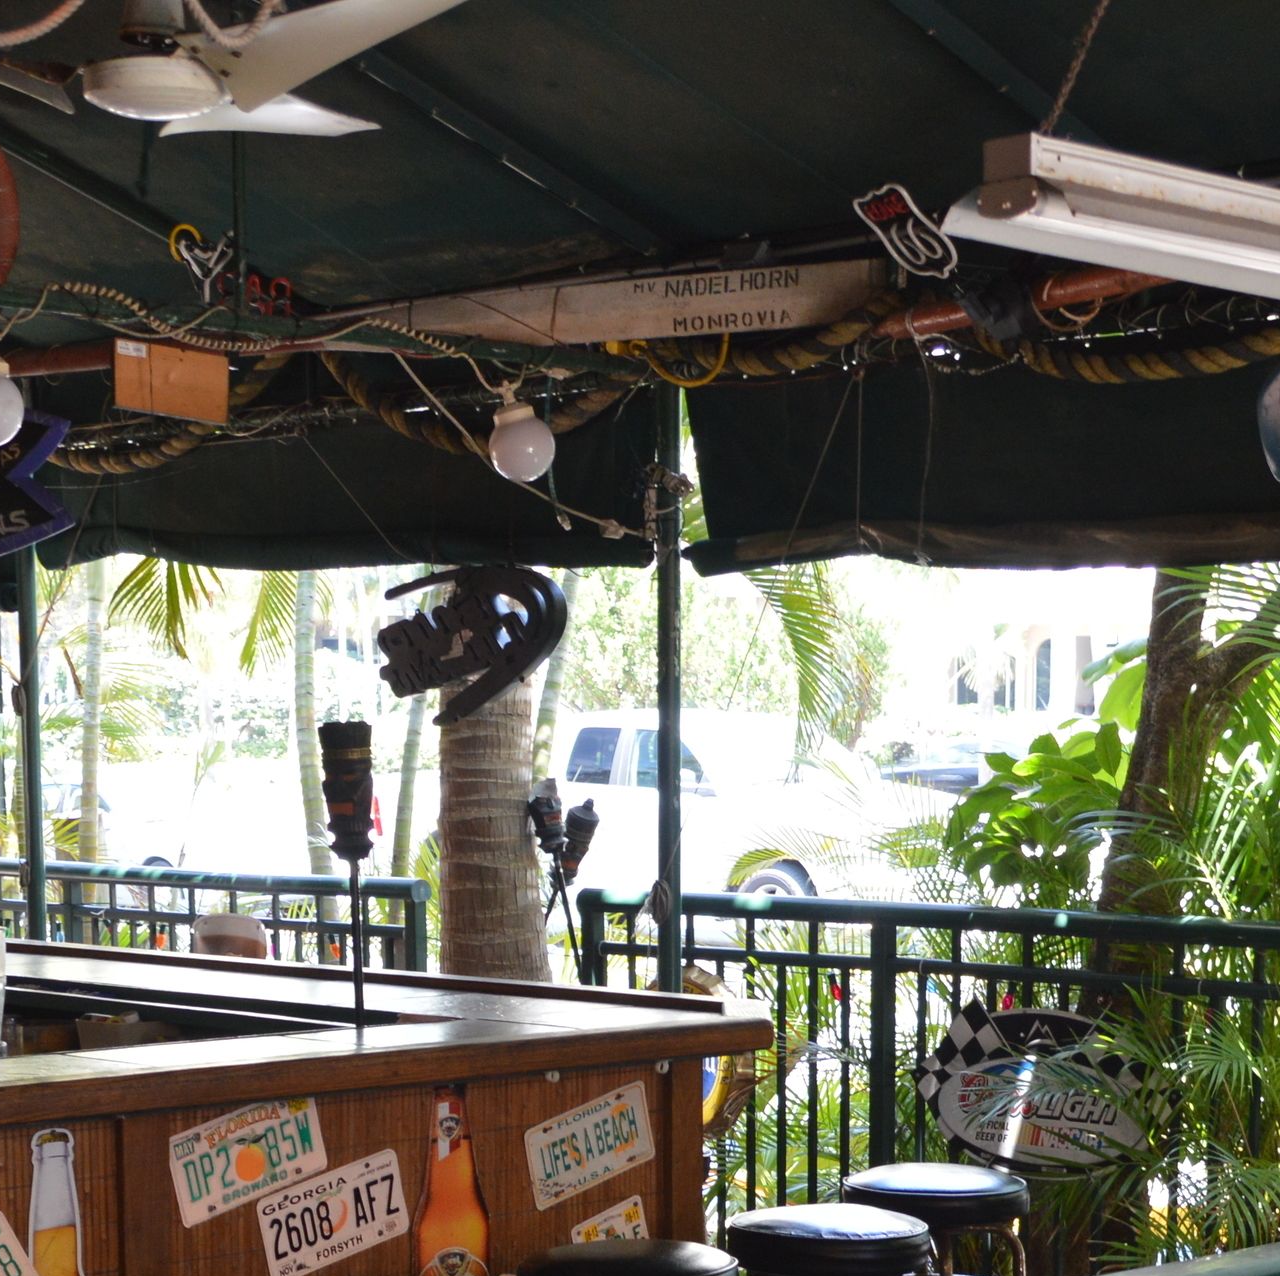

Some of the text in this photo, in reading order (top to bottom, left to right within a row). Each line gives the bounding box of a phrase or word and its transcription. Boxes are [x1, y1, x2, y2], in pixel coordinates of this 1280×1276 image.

[672, 309, 793, 333] MONROVIA
[556, 1100, 612, 1130] FLORIDA
[1036, 1089, 1118, 1126] LIGHT
[539, 1105, 640, 1181] LIFE'S A BEACH
[975, 1131, 1008, 1144] BEER OF
[262, 1176, 348, 1217] GEORGIA
[269, 1173, 400, 1261] 2608 AFZ
[315, 1234, 364, 1261] FORSYTH
